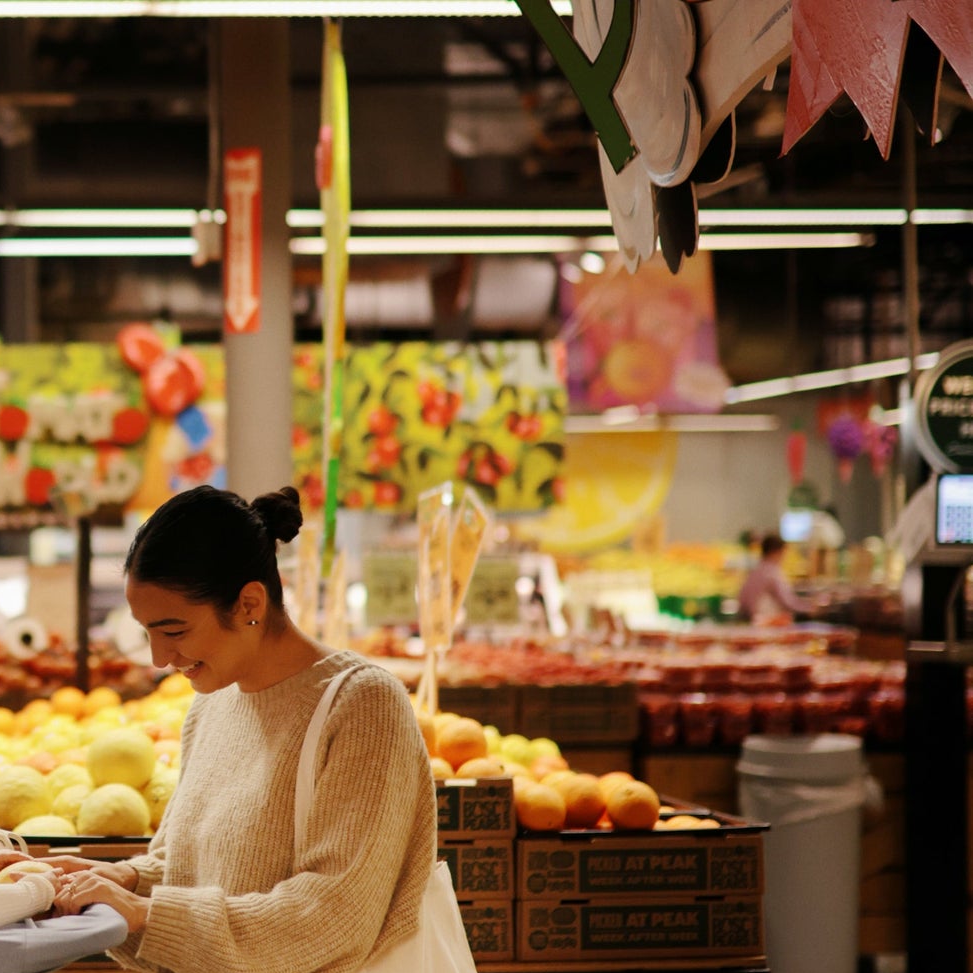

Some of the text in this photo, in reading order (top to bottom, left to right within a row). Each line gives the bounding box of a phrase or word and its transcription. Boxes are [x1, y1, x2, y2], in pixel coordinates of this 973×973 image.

[929, 397, 973, 416] PRIC
[625, 856, 646, 870] AT
[650, 854, 698, 869] PEAK
[626, 912, 647, 927] AT
[651, 911, 699, 927] PEAK
